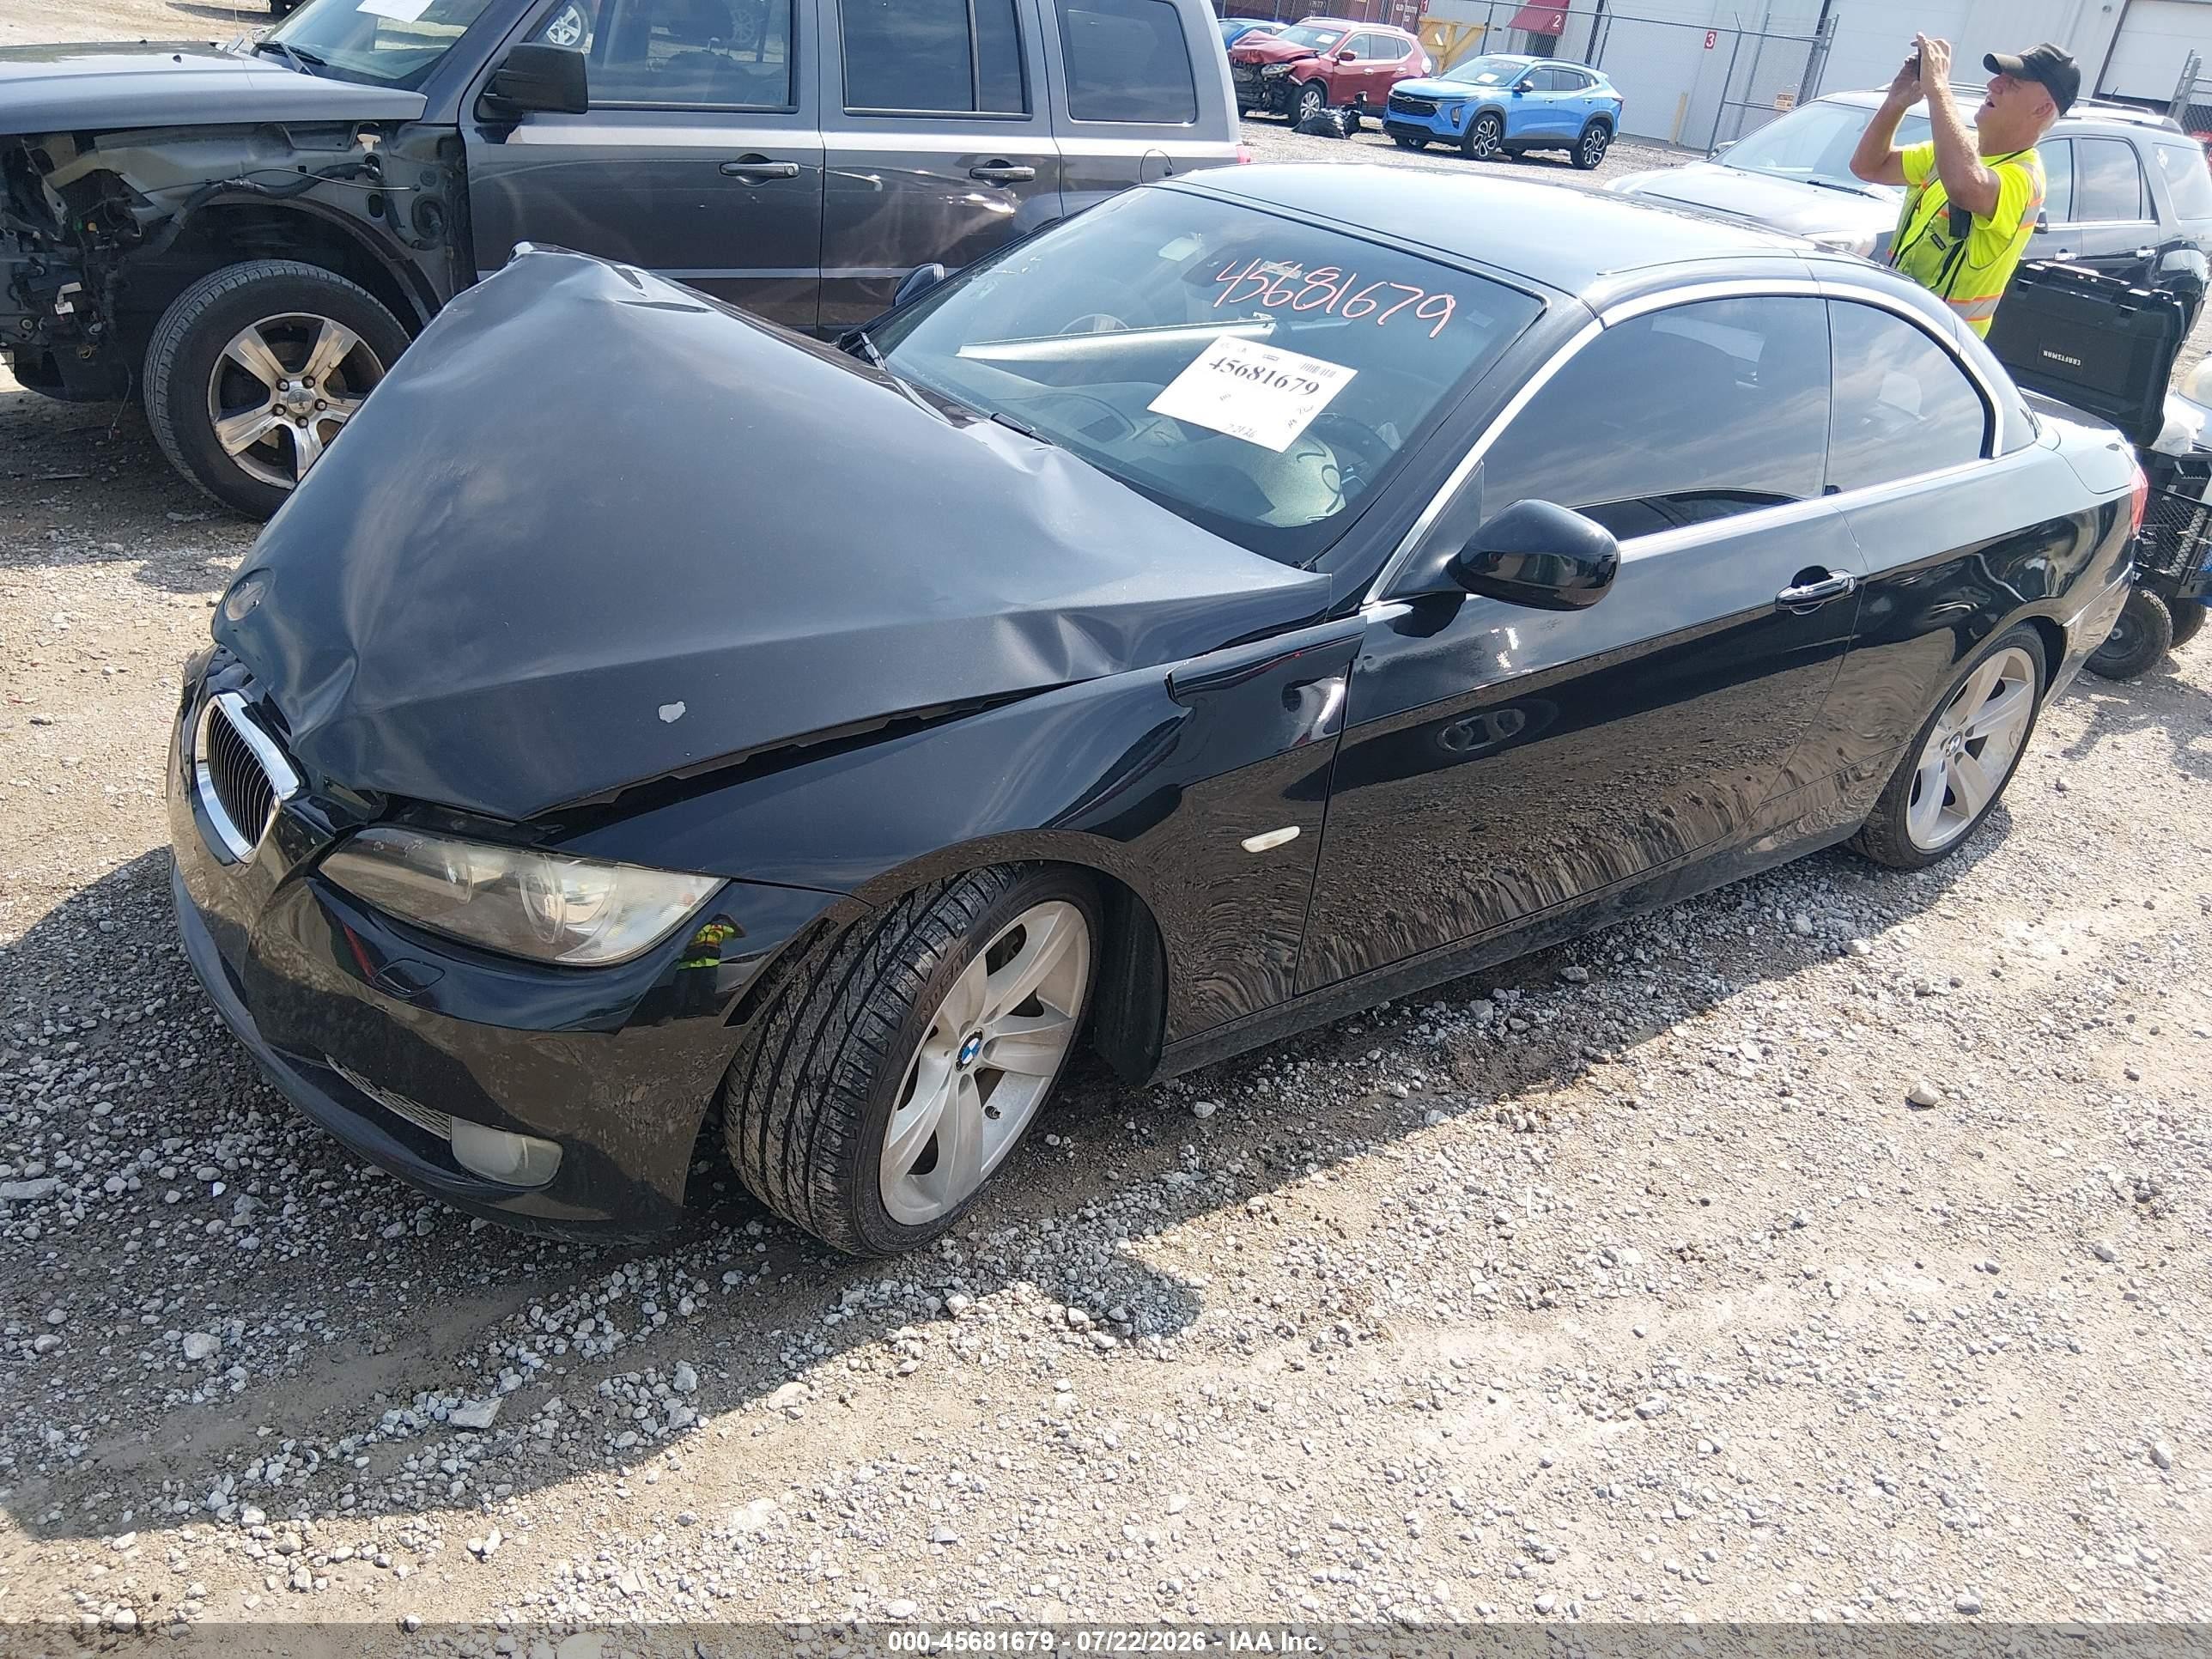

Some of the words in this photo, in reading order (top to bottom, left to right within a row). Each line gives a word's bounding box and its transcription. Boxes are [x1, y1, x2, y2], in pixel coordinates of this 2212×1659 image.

[1553, 15, 1560, 27] 2
[1706, 33, 1715, 47] 3
[1212, 258, 1456, 338] 45681679
[2043, 350, 2081, 366] CRAFTSMAN
[1209, 356, 1320, 396] 45681679
